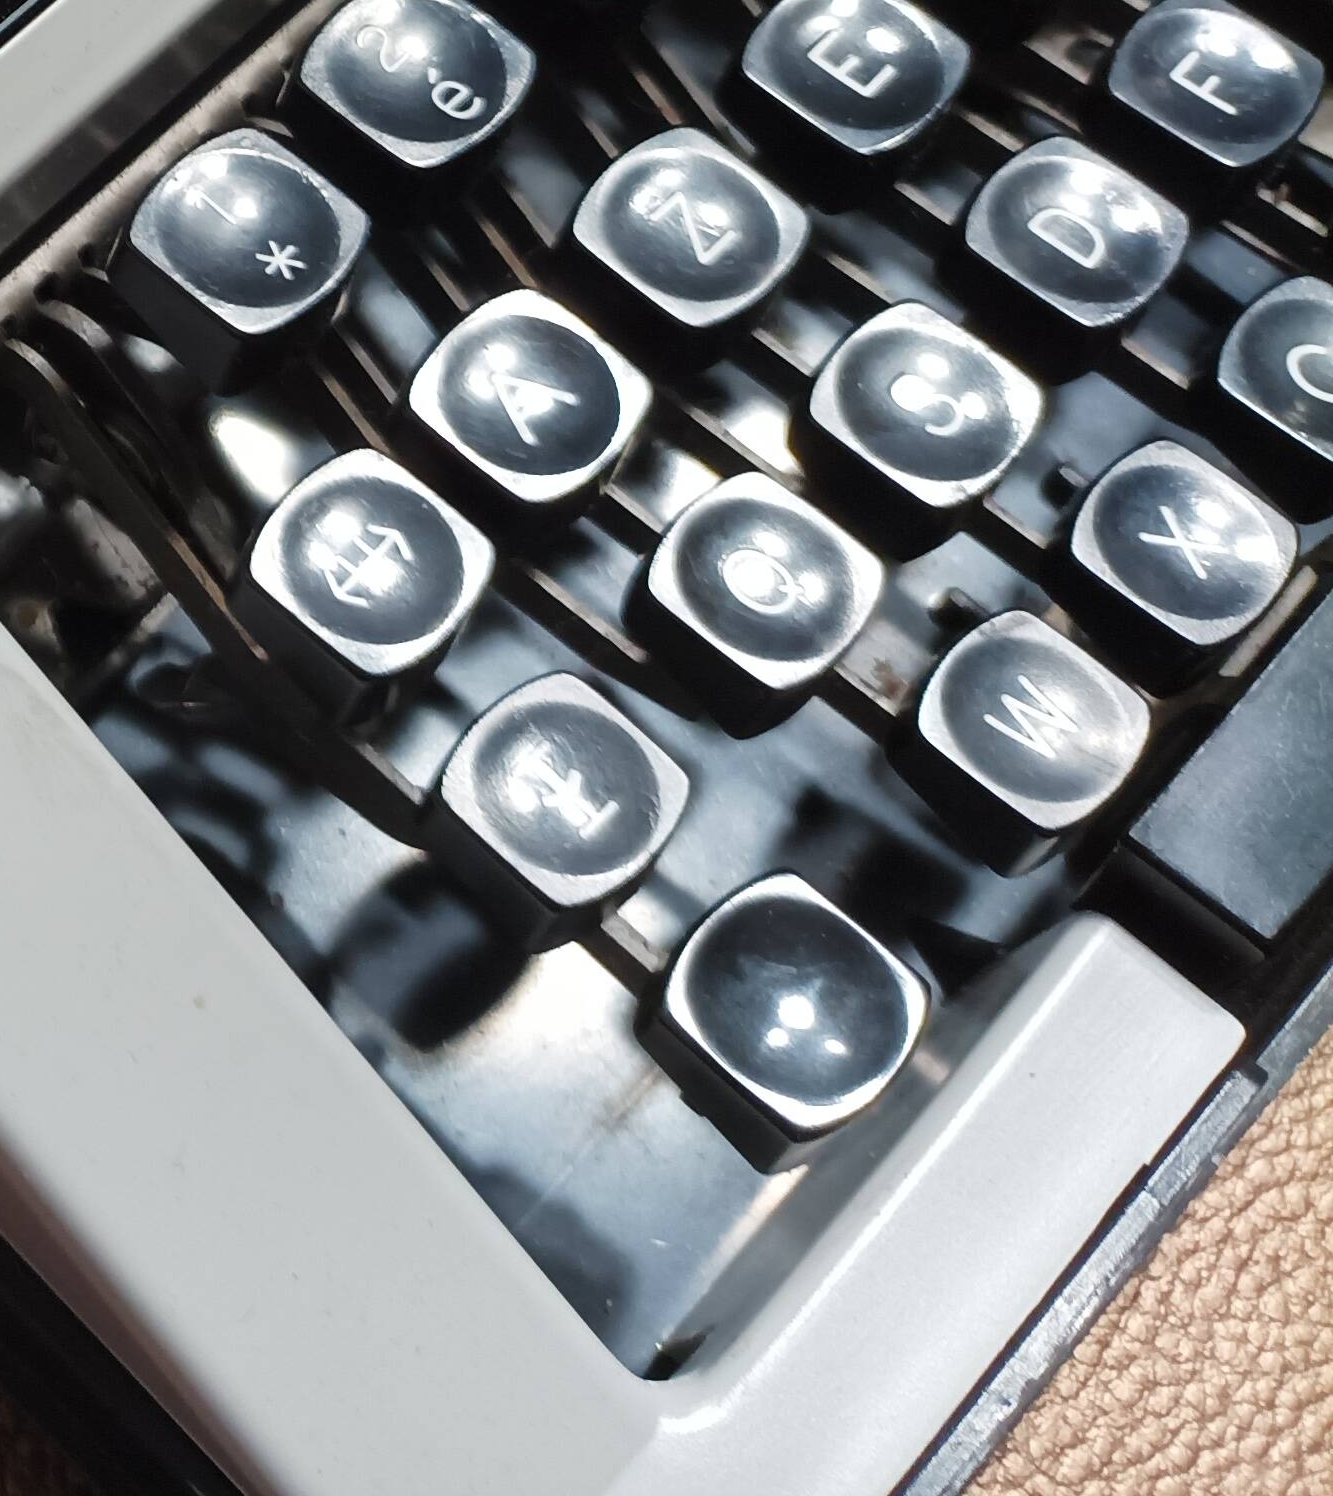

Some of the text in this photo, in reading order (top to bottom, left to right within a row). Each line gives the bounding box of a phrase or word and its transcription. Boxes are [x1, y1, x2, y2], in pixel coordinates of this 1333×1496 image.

[355, 25, 412, 73] 2
[806, 28, 895, 99] E
[1168, 49, 1238, 116] F
[646, 191, 738, 266] Z
[1027, 206, 1108, 271] D
[491, 371, 581, 446] A
[1137, 505, 1232, 581] X
[982, 673, 1082, 760] W
